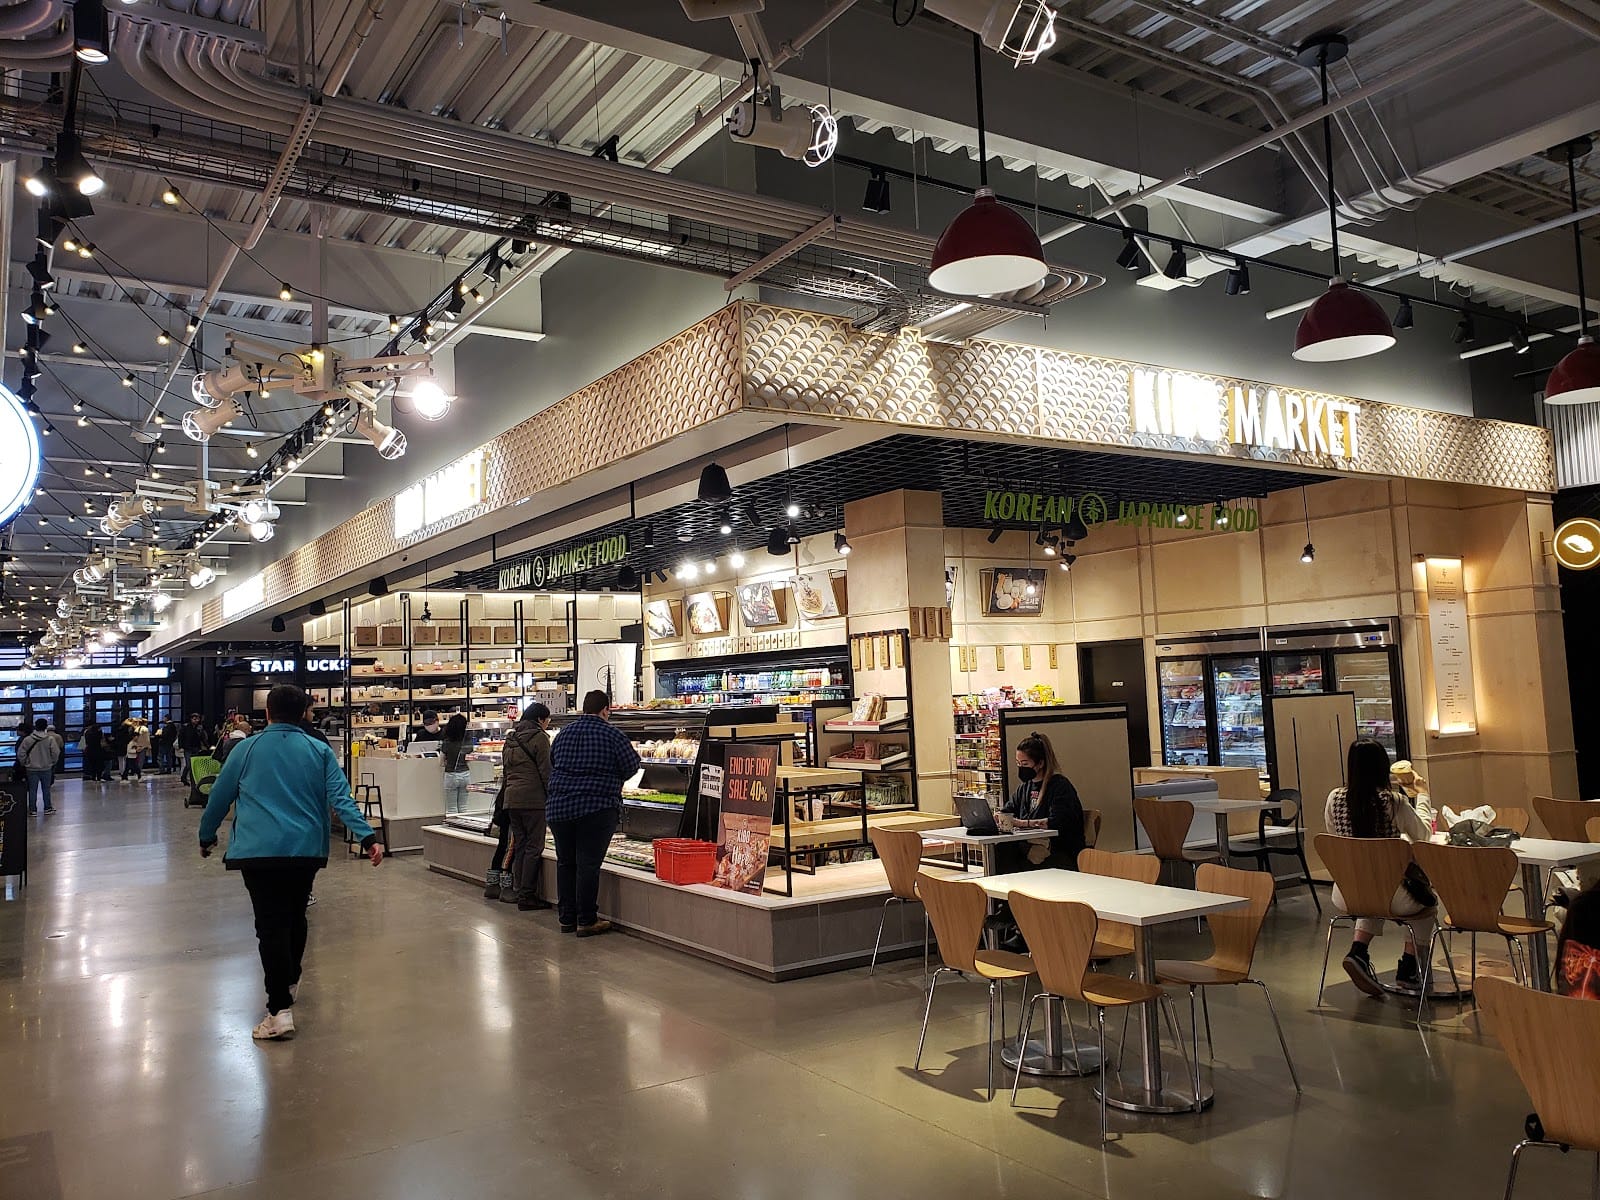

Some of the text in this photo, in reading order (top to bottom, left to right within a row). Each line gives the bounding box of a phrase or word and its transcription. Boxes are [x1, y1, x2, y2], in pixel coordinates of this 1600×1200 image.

[1229, 386, 1361, 459] MARKET
[984, 490, 1074, 524] KOREAN
[1115, 500, 1205, 531] JAPANESE
[1210, 506, 1259, 532] FOOD
[498, 562, 531, 591] KOREAN
[546, 543, 593, 580] JAPANESE
[596, 534, 627, 567] FOOD
[250, 660, 349, 673] STARUCKS
[729, 756, 772, 777] END OF DAY
[728, 779, 768, 802] SALE 40%
